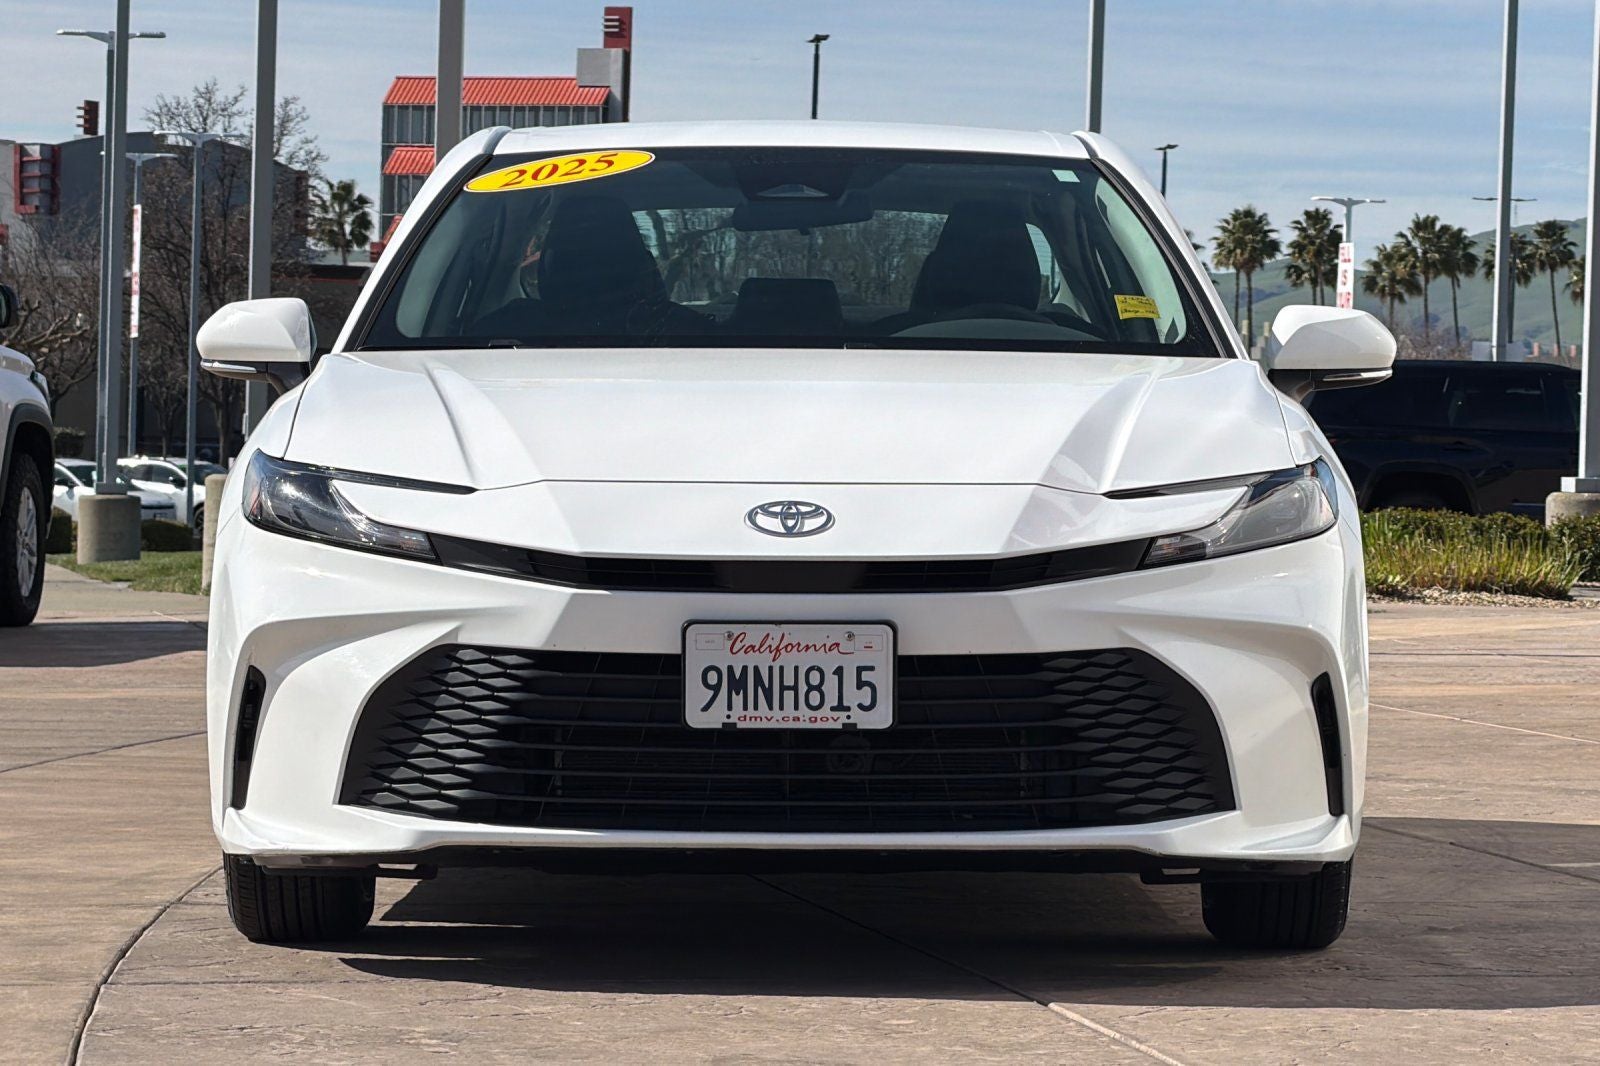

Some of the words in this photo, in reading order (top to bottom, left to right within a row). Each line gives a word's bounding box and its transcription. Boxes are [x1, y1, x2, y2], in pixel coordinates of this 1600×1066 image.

[499, 153, 618, 187] 2025
[729, 632, 854, 662] California
[700, 665, 877, 712] 9MNH815
[737, 714, 840, 723] dmv.ca.gov
